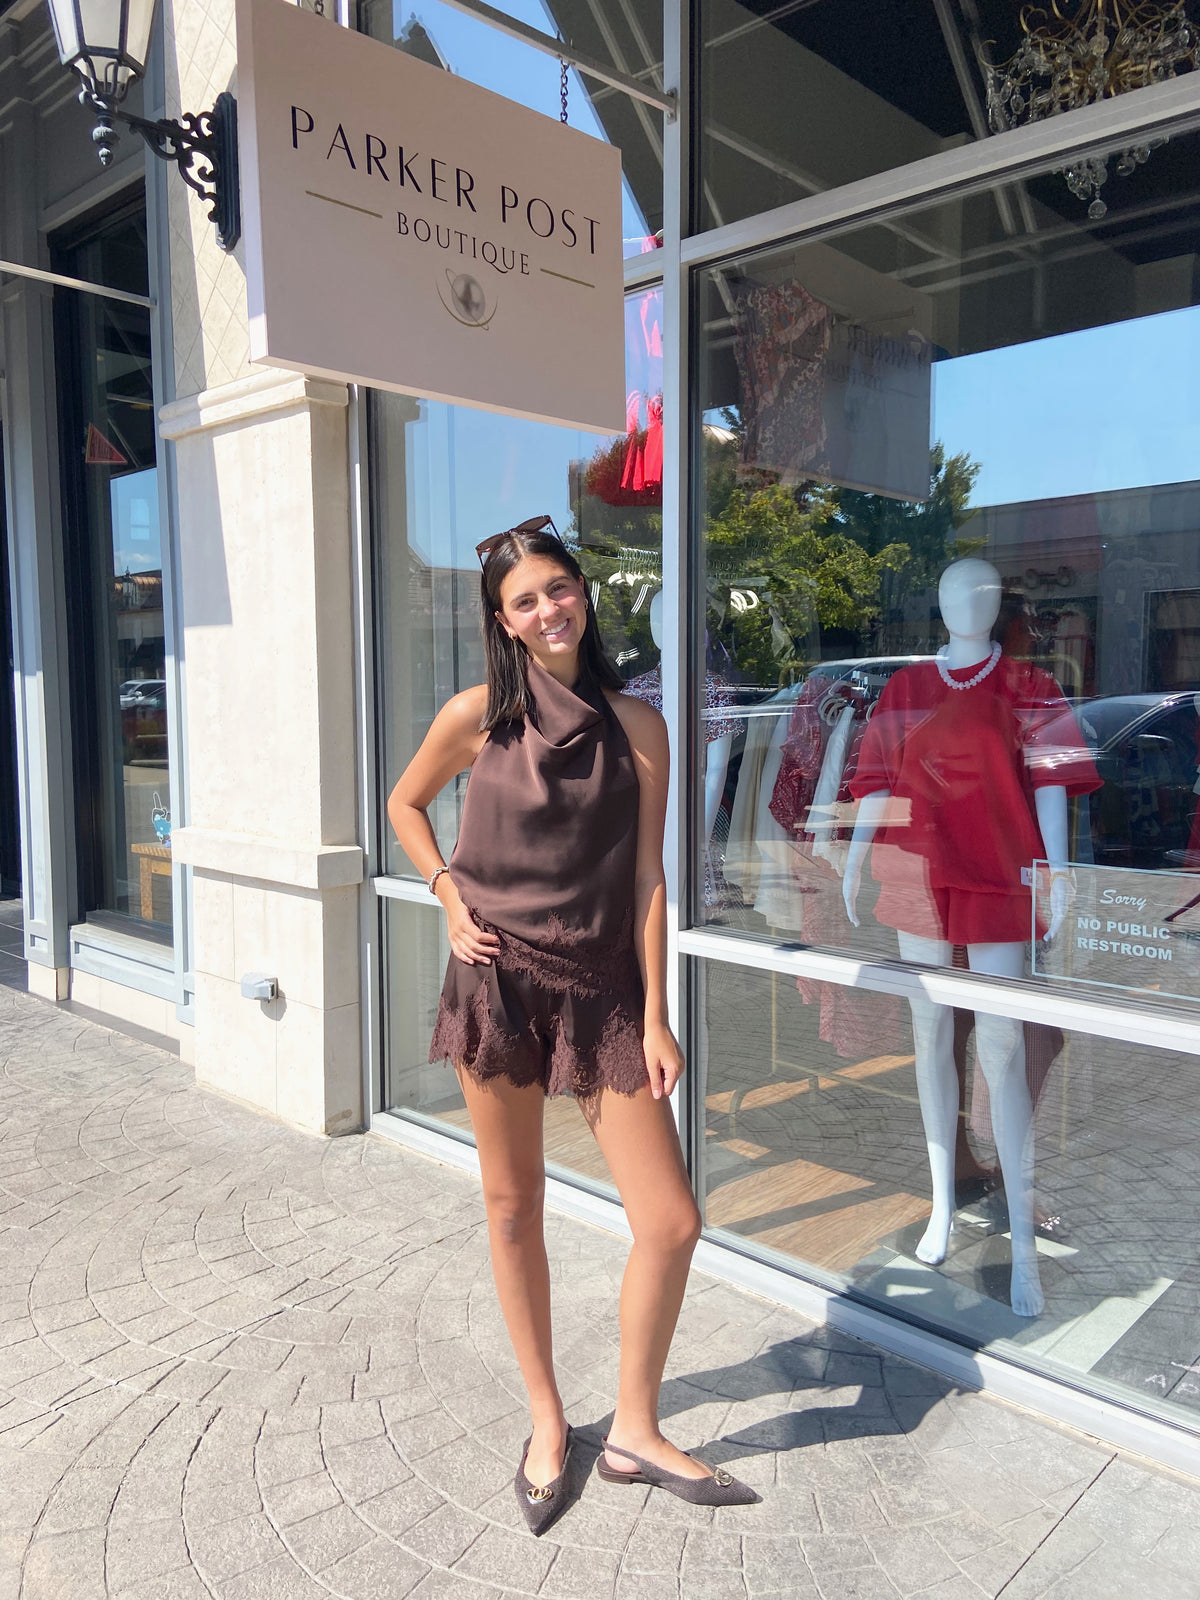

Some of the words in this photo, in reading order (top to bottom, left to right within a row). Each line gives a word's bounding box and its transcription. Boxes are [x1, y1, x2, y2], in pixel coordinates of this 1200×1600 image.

[291, 105, 477, 212] PARKER
[500, 185, 601, 254] POST
[397, 211, 530, 275] BOUTIQUE
[1100, 889, 1147, 911] Sorry
[1077, 917, 1101, 931] NO
[1106, 920, 1170, 940] PUBLIC
[1077, 937, 1172, 961] RESTROOM
